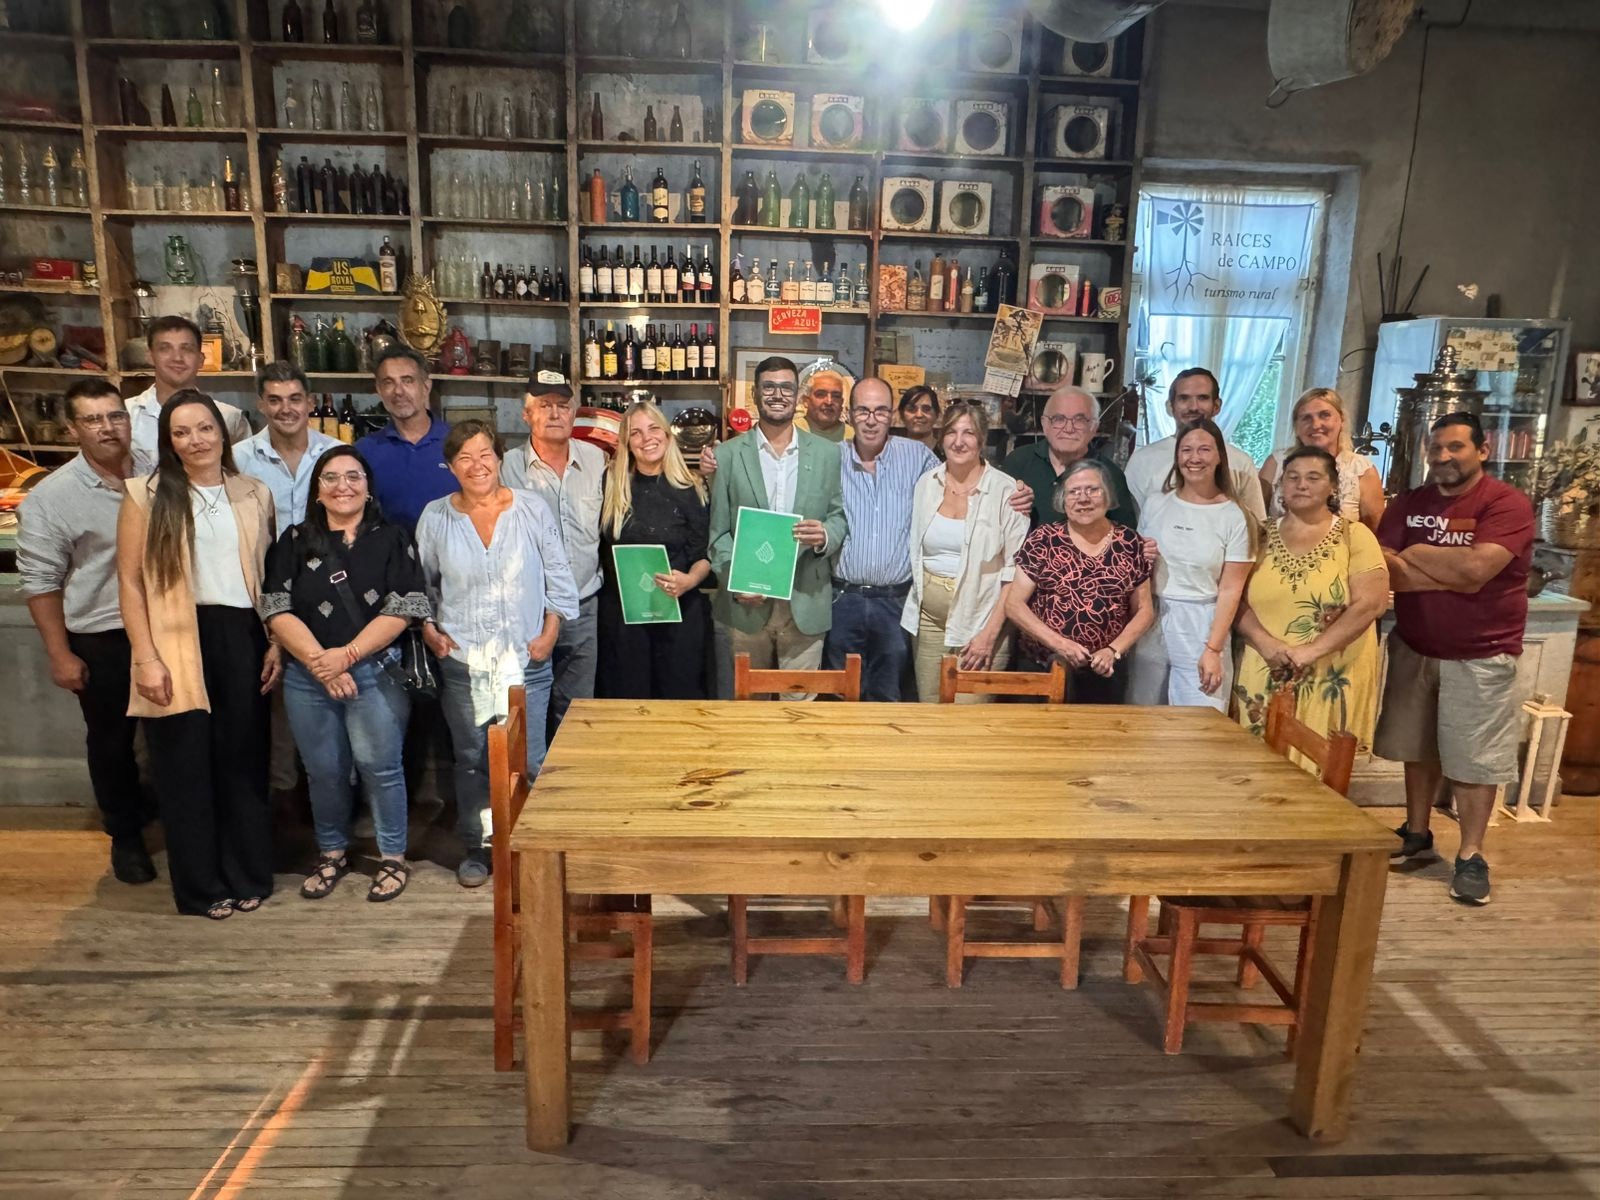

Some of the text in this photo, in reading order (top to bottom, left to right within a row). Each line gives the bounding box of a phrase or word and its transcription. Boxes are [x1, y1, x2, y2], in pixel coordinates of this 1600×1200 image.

[1211, 232, 1272, 248] RAICES
[1218, 253, 1297, 270] de CAMPO
[331, 276, 354, 284] ROYAL
[1204, 287, 1278, 299] turismo rural
[772, 309, 807, 325] CERVEZA
[1427, 529, 1475, 545] JEANS
